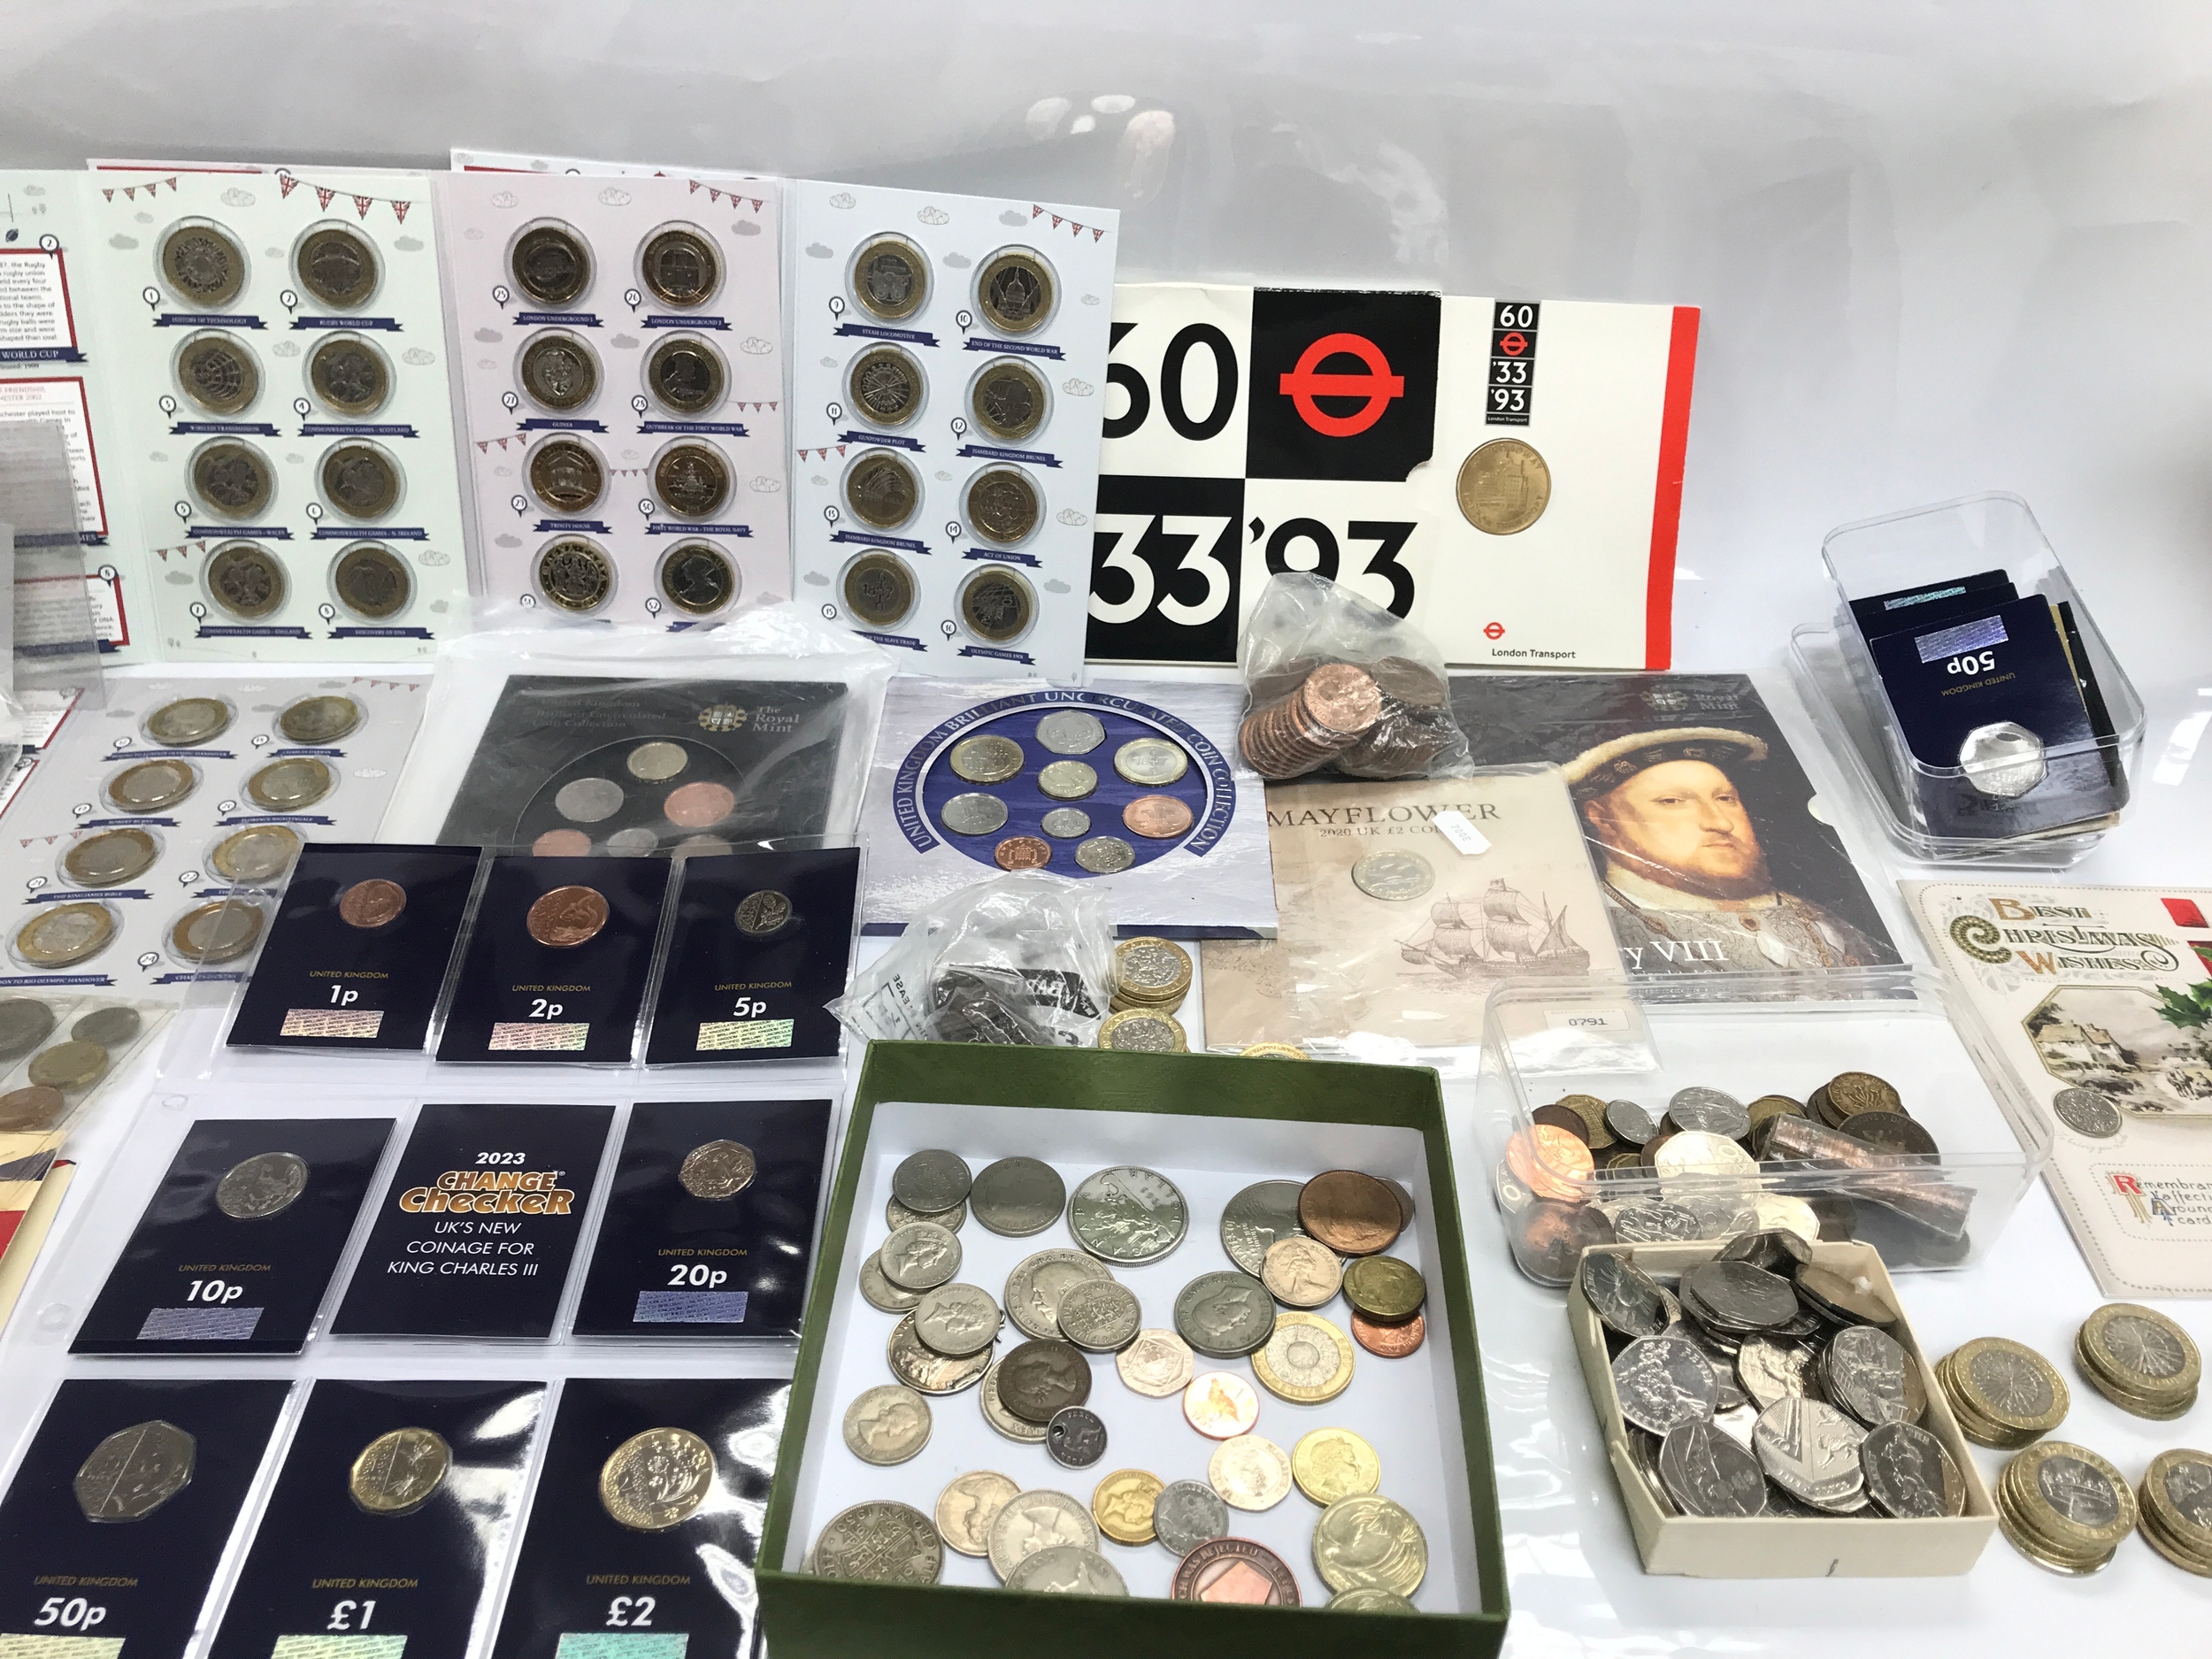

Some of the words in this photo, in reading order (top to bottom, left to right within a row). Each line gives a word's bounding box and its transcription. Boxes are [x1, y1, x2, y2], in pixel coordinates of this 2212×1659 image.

[1499, 305, 1534, 328] 60
[880, 330, 915, 340] LOCOMOTIVE
[3, 350, 37, 359] WORLD
[40, 349, 59, 358] CUP
[1492, 361, 1527, 385] '33
[1490, 389, 1525, 412] '93
[999, 450, 1025, 459] KINGDOM
[871, 536, 895, 546] KINGDOM
[1492, 648, 1527, 657] London
[1529, 649, 1576, 660] Transport
[1947, 650, 1995, 676] 50p
[1940, 680, 1983, 696] KINGDOM
[1985, 672, 2016, 686] UNITED
[756, 714, 800, 724] Royal
[945, 694, 1036, 732] BRILLIANT
[752, 724, 792, 733] Mint
[1187, 733, 1223, 766] COIN
[896, 729, 949, 795] KINGDOM
[1190, 766, 1233, 851] COLLECTION
[1267, 803, 1502, 828] MAYFLOWER
[896, 797, 933, 849] UNITED
[1319, 827, 1353, 838] 2020
[1356, 826, 1382, 836] UK
[1386, 825, 1405, 835] £2
[1409, 825, 1440, 835] COI
[1990, 897, 2093, 921] BEST
[1649, 940, 1729, 963] VIII
[1949, 915, 2179, 972] CHRISTMAS
[2016, 950, 2142, 975] WISHES
[310, 970, 342, 979] UNITED
[328, 984, 358, 1007] 1p
[512, 983, 545, 992] UNITED
[547, 984, 591, 993] KINGDOM
[714, 982, 747, 991] UNITED
[749, 980, 792, 989] KINGDOM
[529, 998, 564, 1020] 2p
[733, 996, 767, 1019] 5p
[1567, 1016, 1609, 1027] 0791
[474, 1152, 526, 1164] 2023
[436, 1171, 559, 1192] CHANGE
[434, 1221, 474, 1234] UK'S
[479, 1222, 521, 1234] NEW
[406, 1241, 493, 1255] COINAGE
[497, 1242, 534, 1256] FOR
[657, 1248, 695, 1256] UNITED
[387, 1261, 435, 1274] KING
[440, 1262, 518, 1276] CHARLES
[522, 1263, 539, 1276] III
[667, 1263, 727, 1290] 20p
[186, 1279, 243, 1304] 10p
[836, 1507, 873, 1532] 1950
[33, 1575, 77, 1586] UNITED
[78, 1576, 138, 1586] KINGDOM
[311, 1578, 356, 1588] UNITED
[358, 1578, 419, 1588] KINGDOM
[586, 1574, 630, 1585] UNITED
[632, 1575, 691, 1585] KINGDOM
[34, 1596, 107, 1631] 50p
[326, 1600, 377, 1630] £1
[605, 1596, 657, 1627] £2
